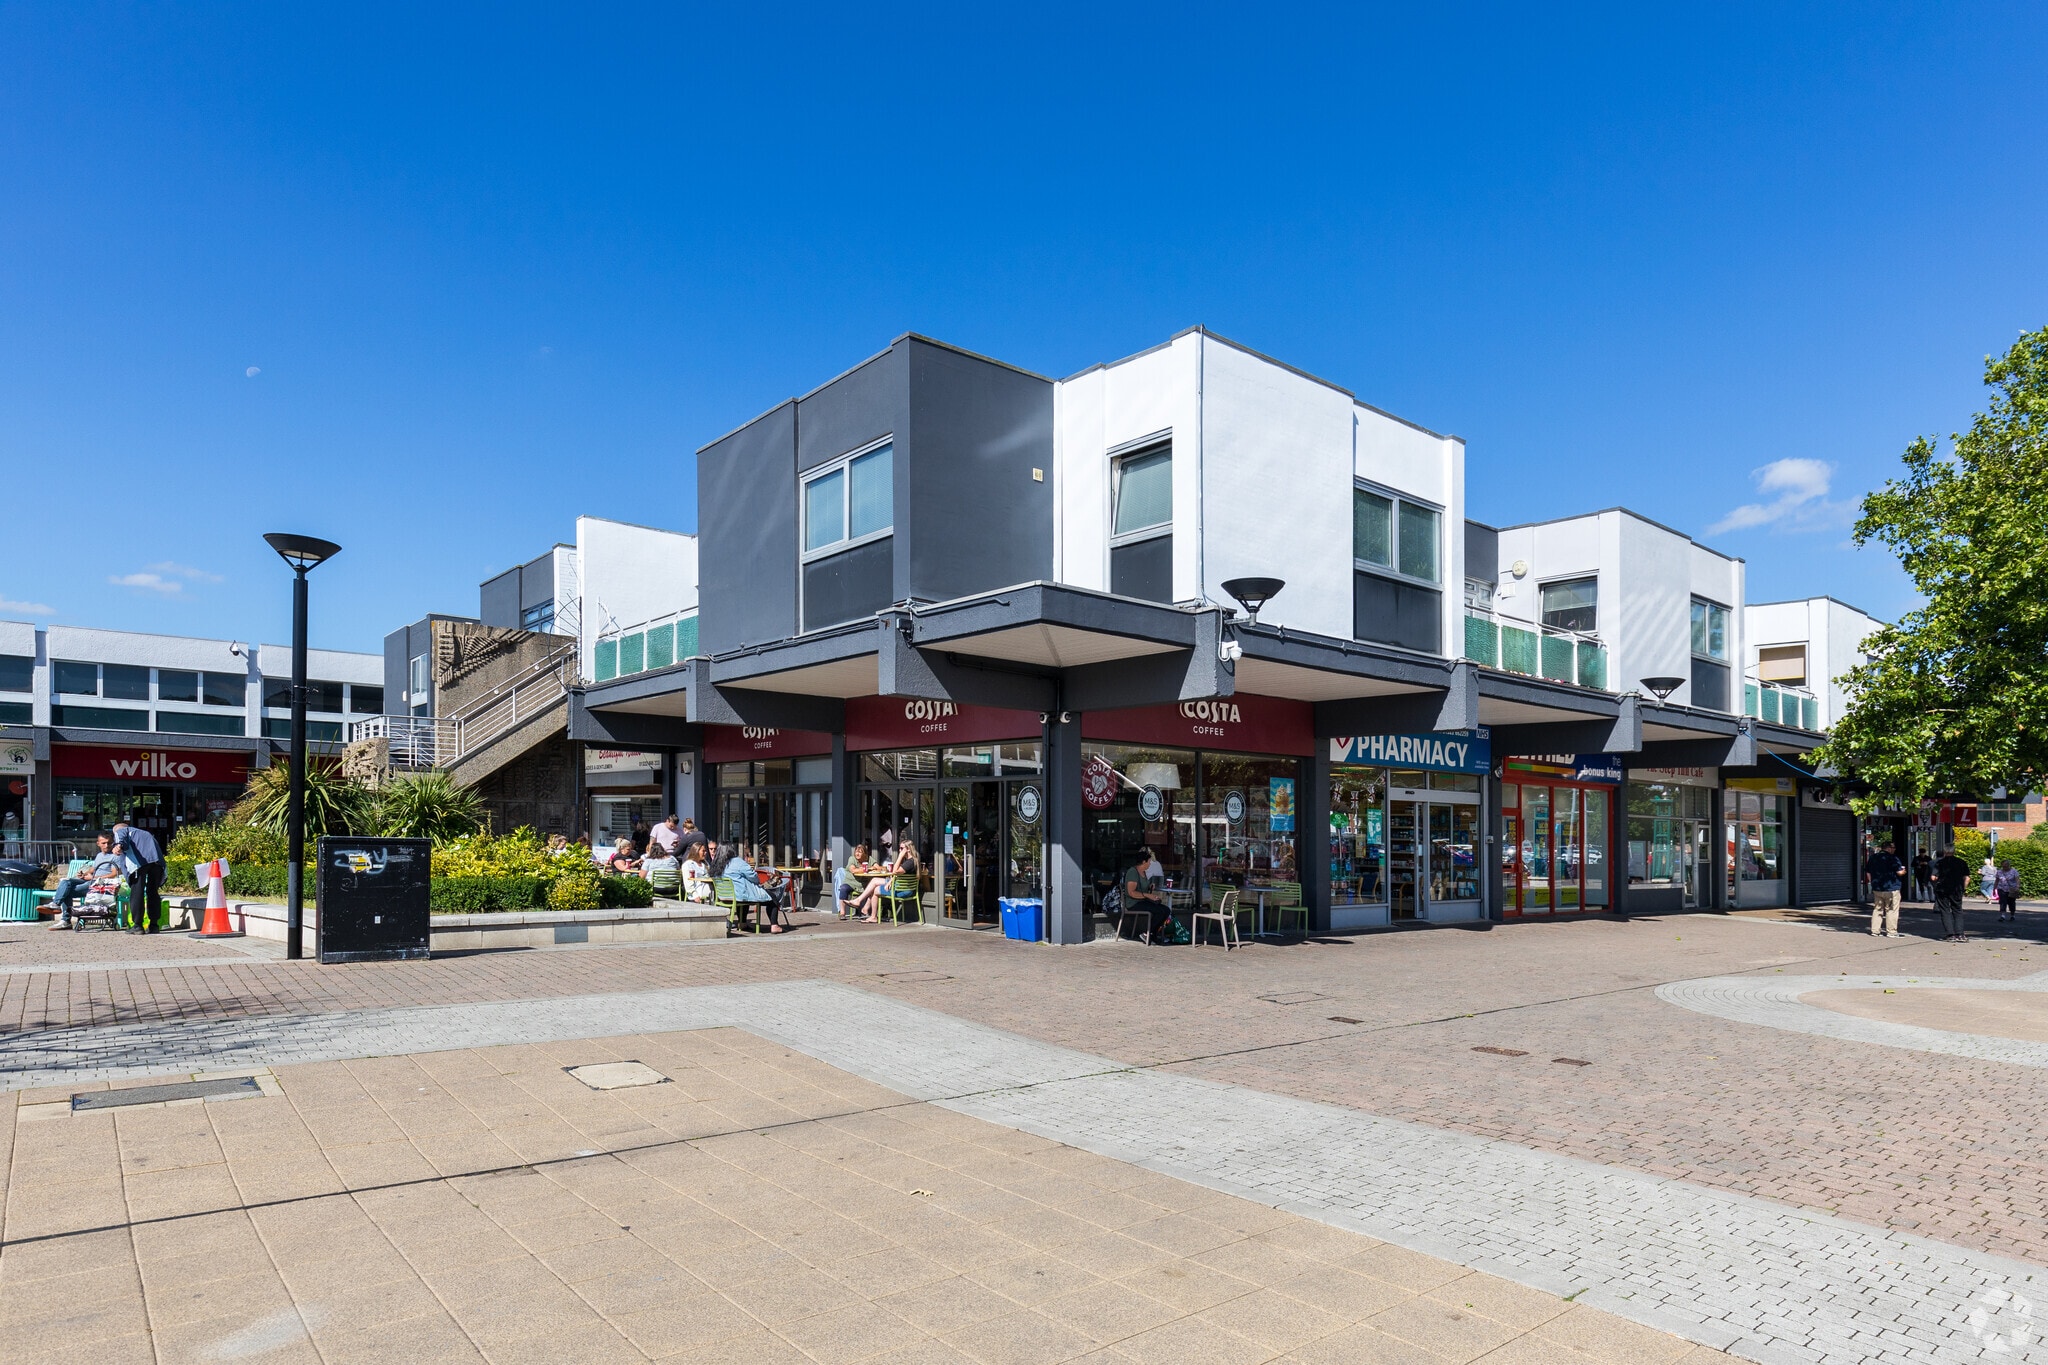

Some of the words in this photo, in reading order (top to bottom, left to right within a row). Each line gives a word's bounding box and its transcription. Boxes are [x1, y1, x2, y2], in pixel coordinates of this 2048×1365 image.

[905, 700, 958, 721] COSTA
[1179, 700, 1242, 723] COSTA
[921, 723, 947, 733] COFFEE
[1193, 725, 1225, 736] COFFEE
[1477, 729, 1489, 739] NHS
[754, 741, 772, 750] COFFEE
[1357, 735, 1468, 768] PHARMACY
[109, 752, 197, 779] wilko
[1087, 763, 1111, 777] COSTA
[1583, 764, 1604, 777] bonus
[1606, 766, 1621, 780] king
[1023, 798, 1036, 807] M&S
[1085, 787, 1113, 805] COFFEE
[1144, 797, 1158, 805] M&S
[1228, 802, 1241, 810] M&S
[1960, 808, 1971, 822] L
